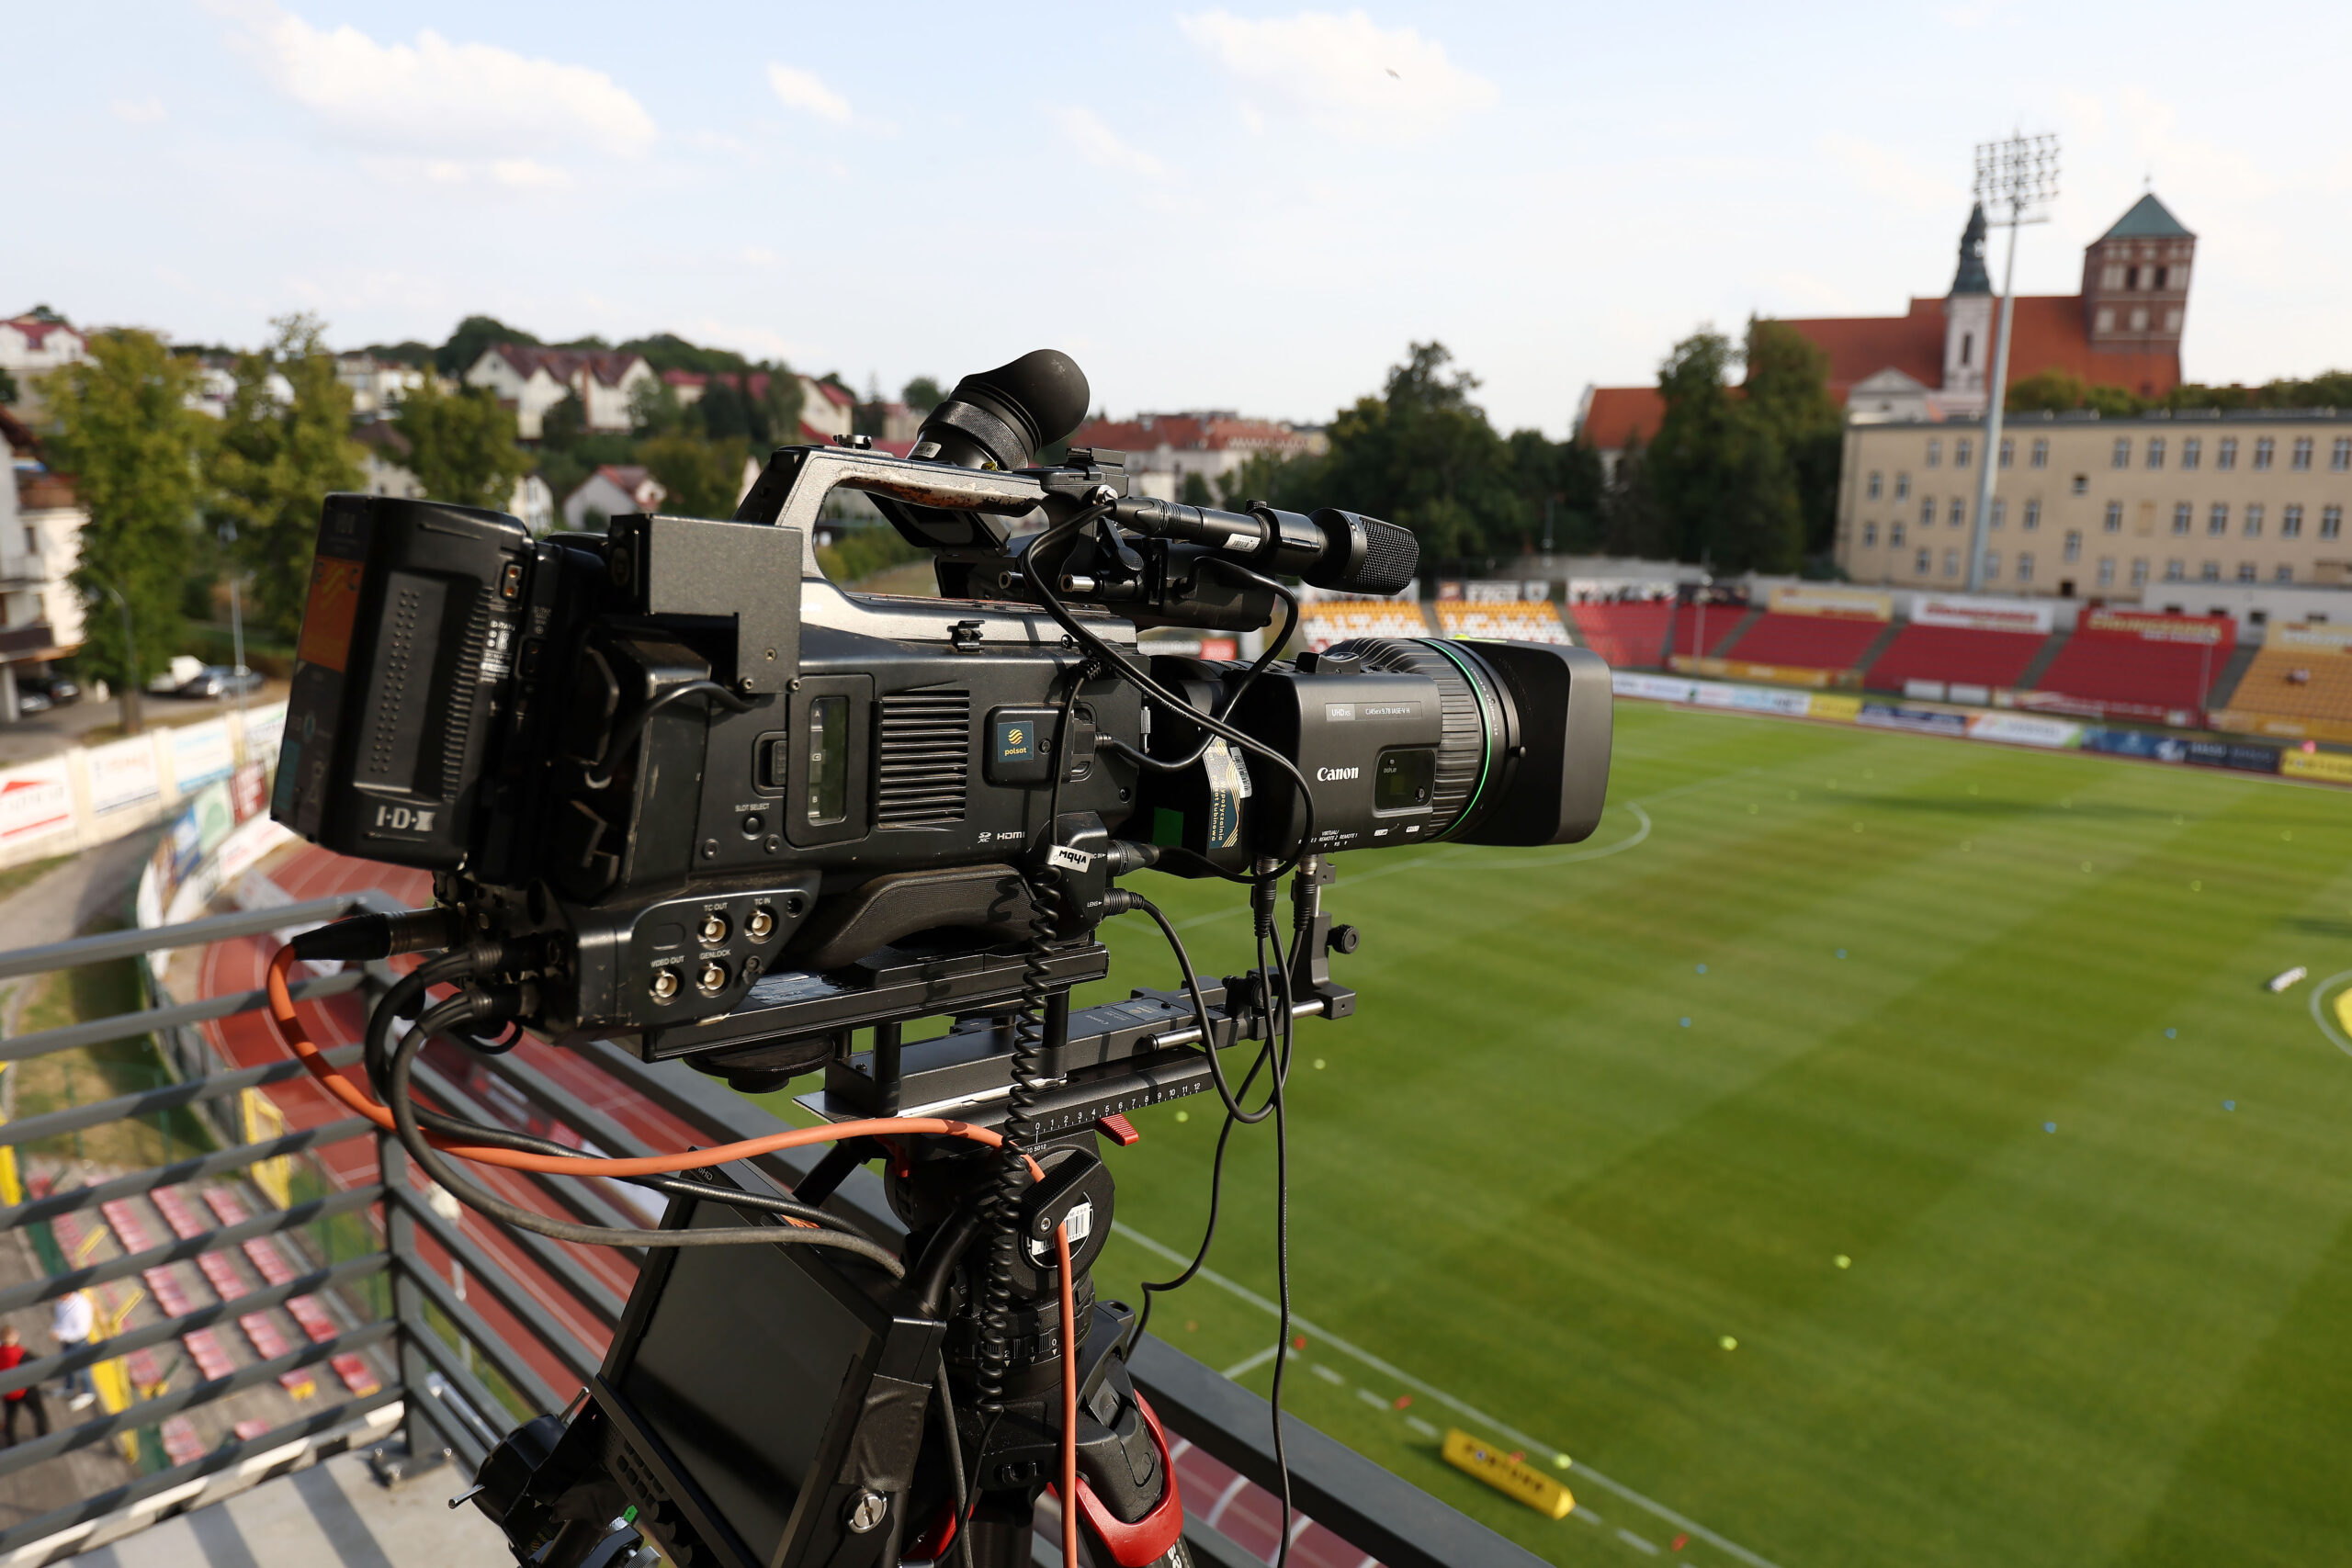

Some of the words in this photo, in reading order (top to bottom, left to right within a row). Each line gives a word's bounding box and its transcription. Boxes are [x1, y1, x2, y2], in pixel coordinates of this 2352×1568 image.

[1004, 747, 1027, 756] polsat
[1317, 767, 1359, 782] Canon
[735, 804, 749, 812] SLOT
[750, 803, 770, 811] SELECT
[997, 831, 1025, 840] HDMI
[714, 902, 728, 910] OUT
[699, 949, 731, 960] GENLOCK
[650, 957, 670, 967] VIDEO
[671, 955, 685, 964] OUT
[1004, 1349, 1011, 1358] 2
[1051, 1338, 1057, 1347] 0
